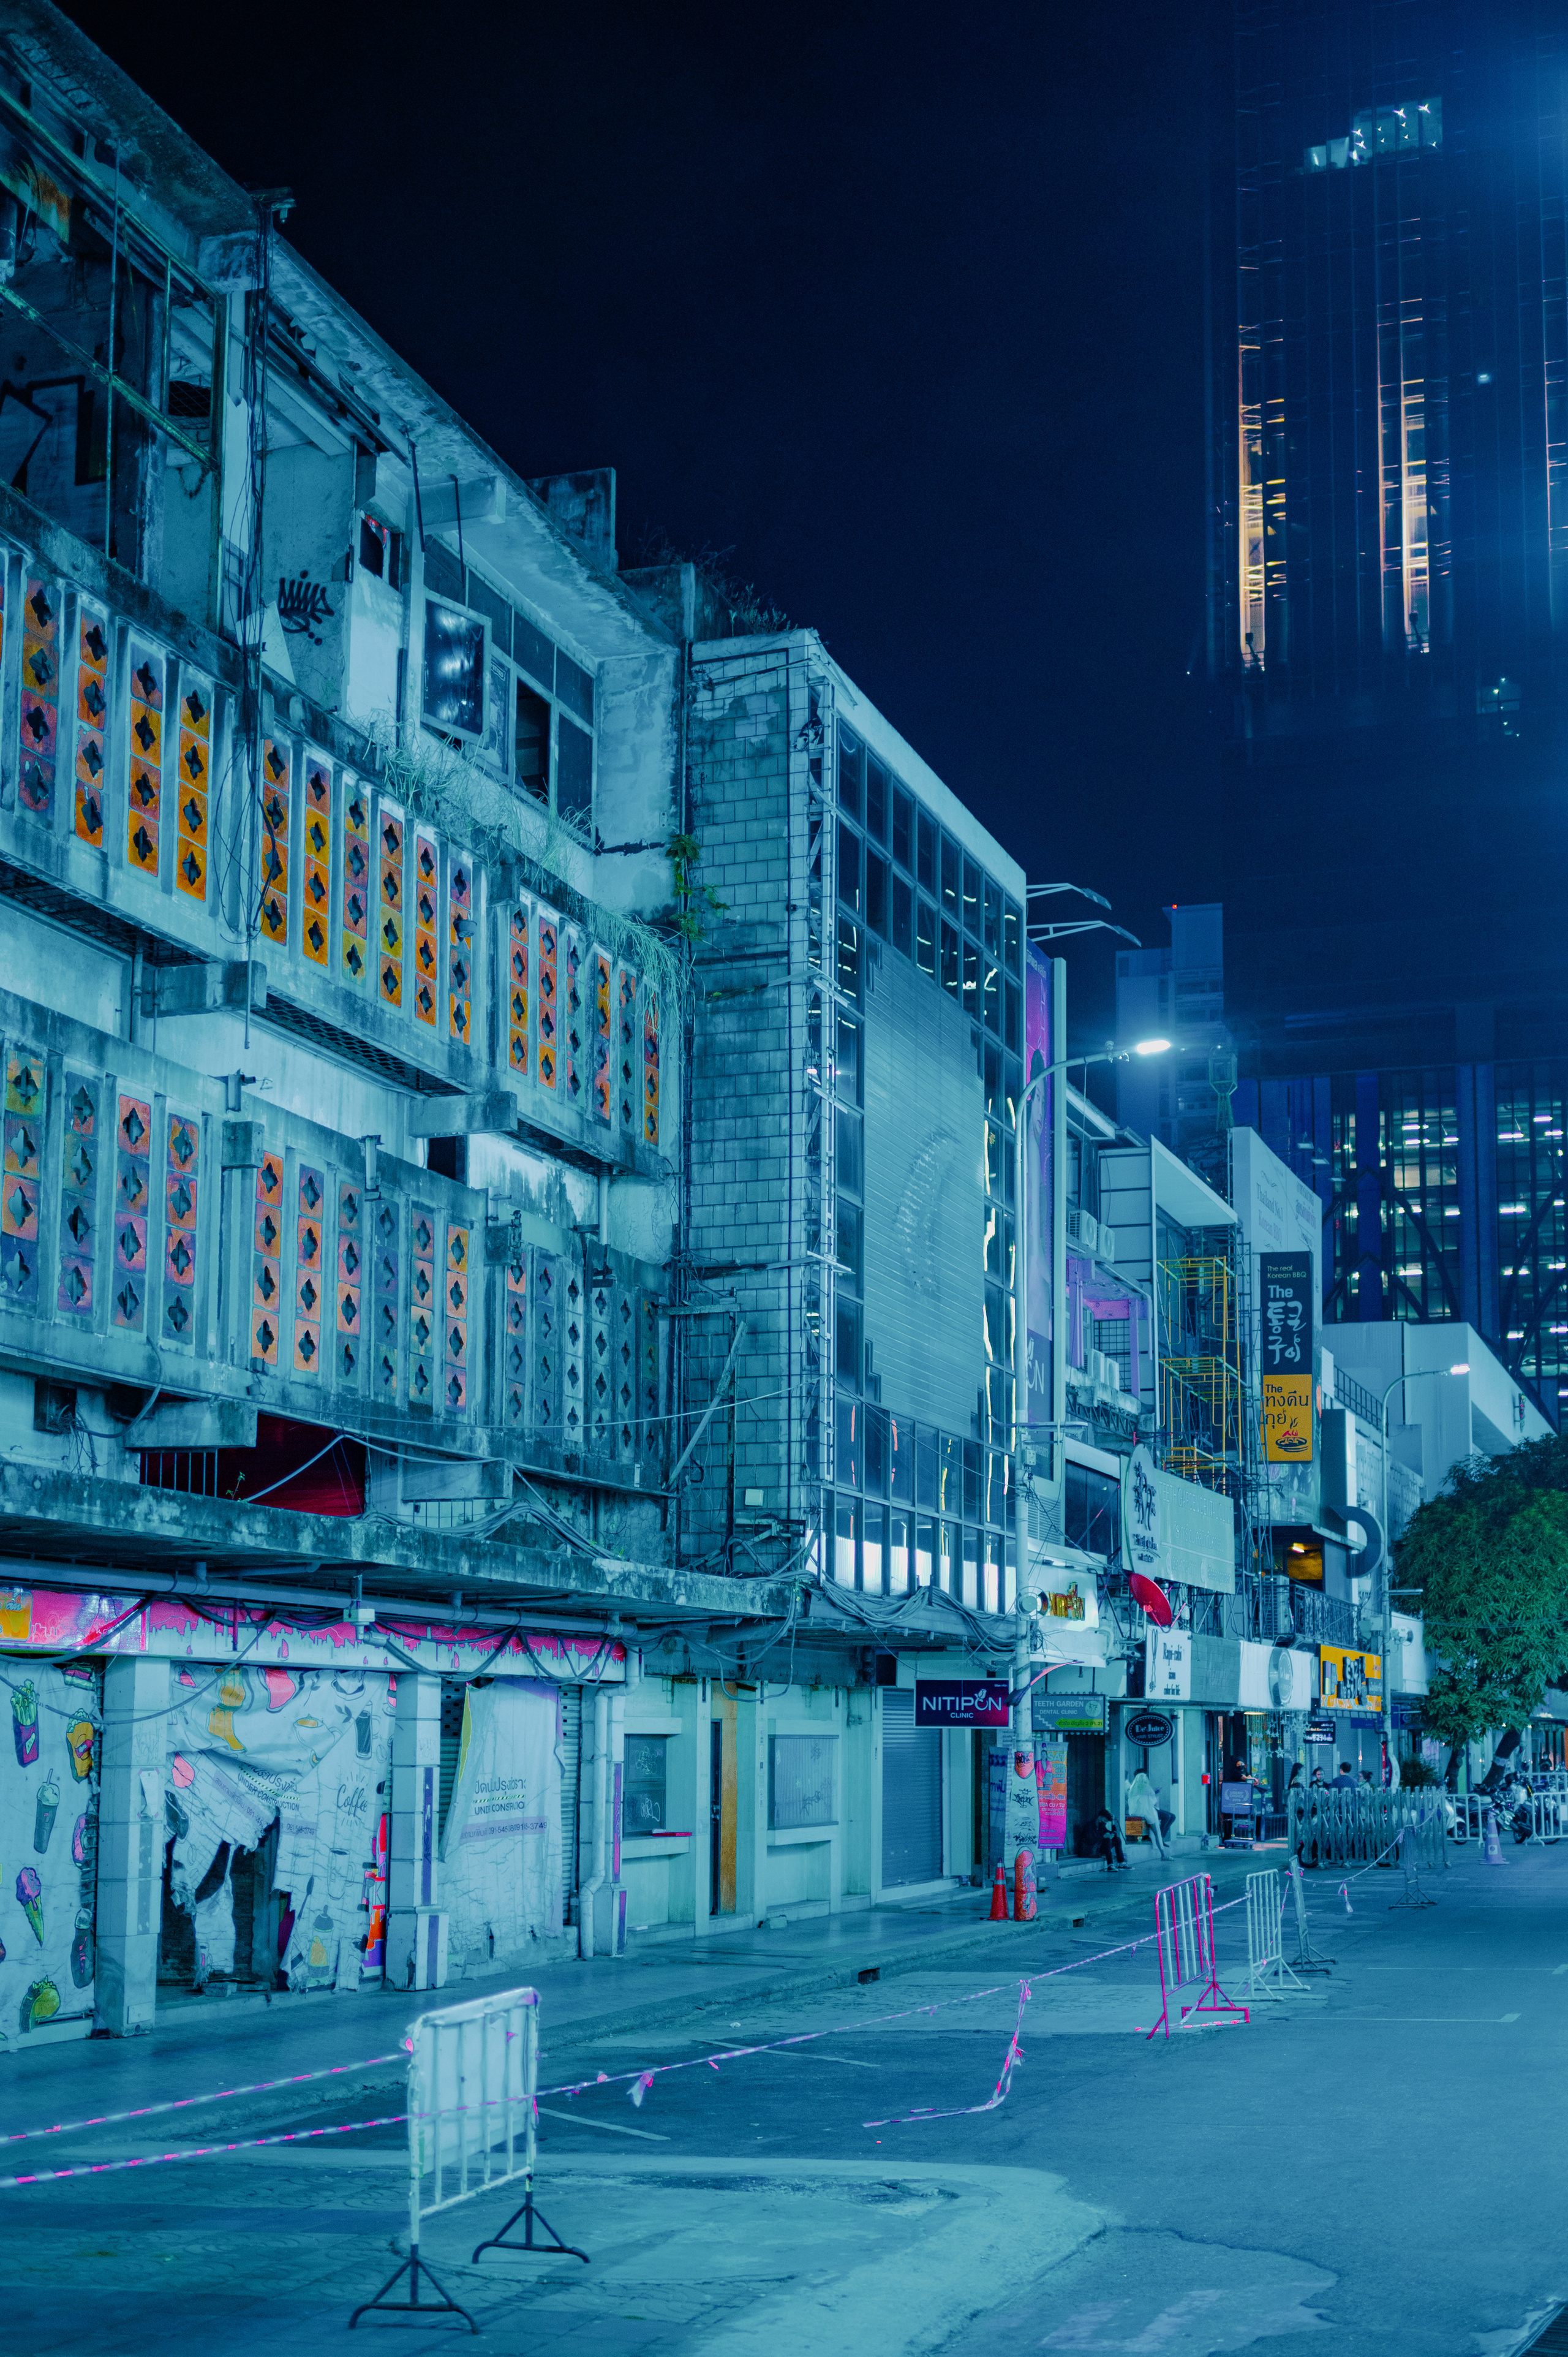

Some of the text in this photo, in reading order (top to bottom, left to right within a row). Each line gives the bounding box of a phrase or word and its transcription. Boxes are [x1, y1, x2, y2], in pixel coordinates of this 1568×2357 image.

[1267, 1285, 1294, 1298] The
[1265, 1384, 1283, 1393] The
[922, 1697, 1002, 1711] NITIPON
[1047, 1752, 1066, 1761] SAT
[237, 1772, 300, 1812] UNDER CONSTRUCTION
[336, 1784, 368, 1817] Coffee
